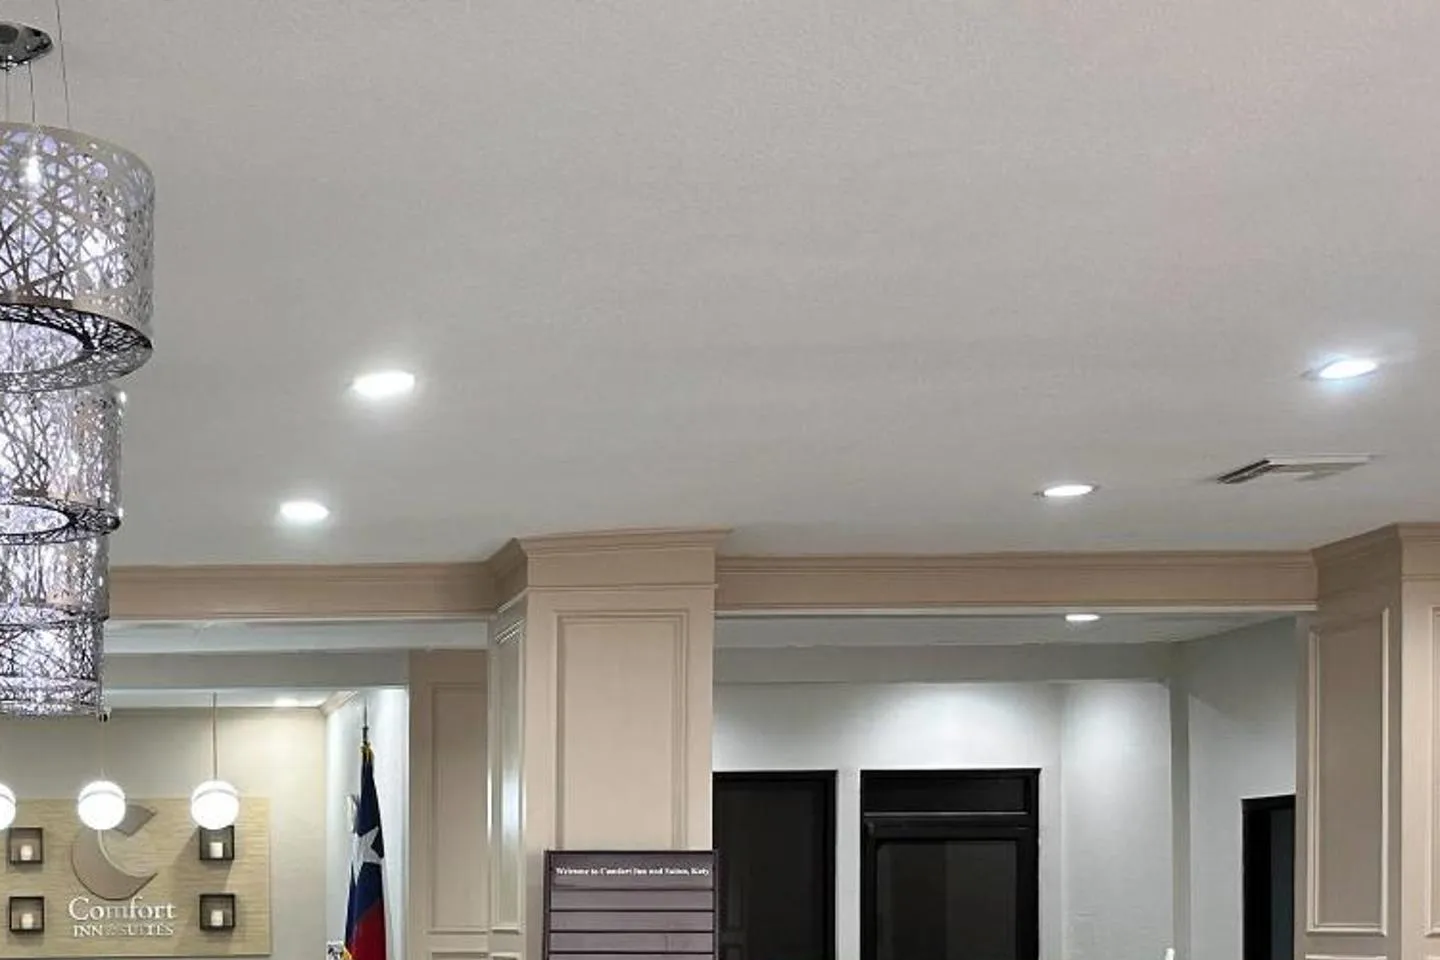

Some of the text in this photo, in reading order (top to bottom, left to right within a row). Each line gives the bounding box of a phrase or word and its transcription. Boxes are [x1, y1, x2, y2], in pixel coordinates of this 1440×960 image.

[68, 896, 177, 920] Comfort
[73, 924, 103, 937] INN
[121, 923, 174, 937] SUITES
